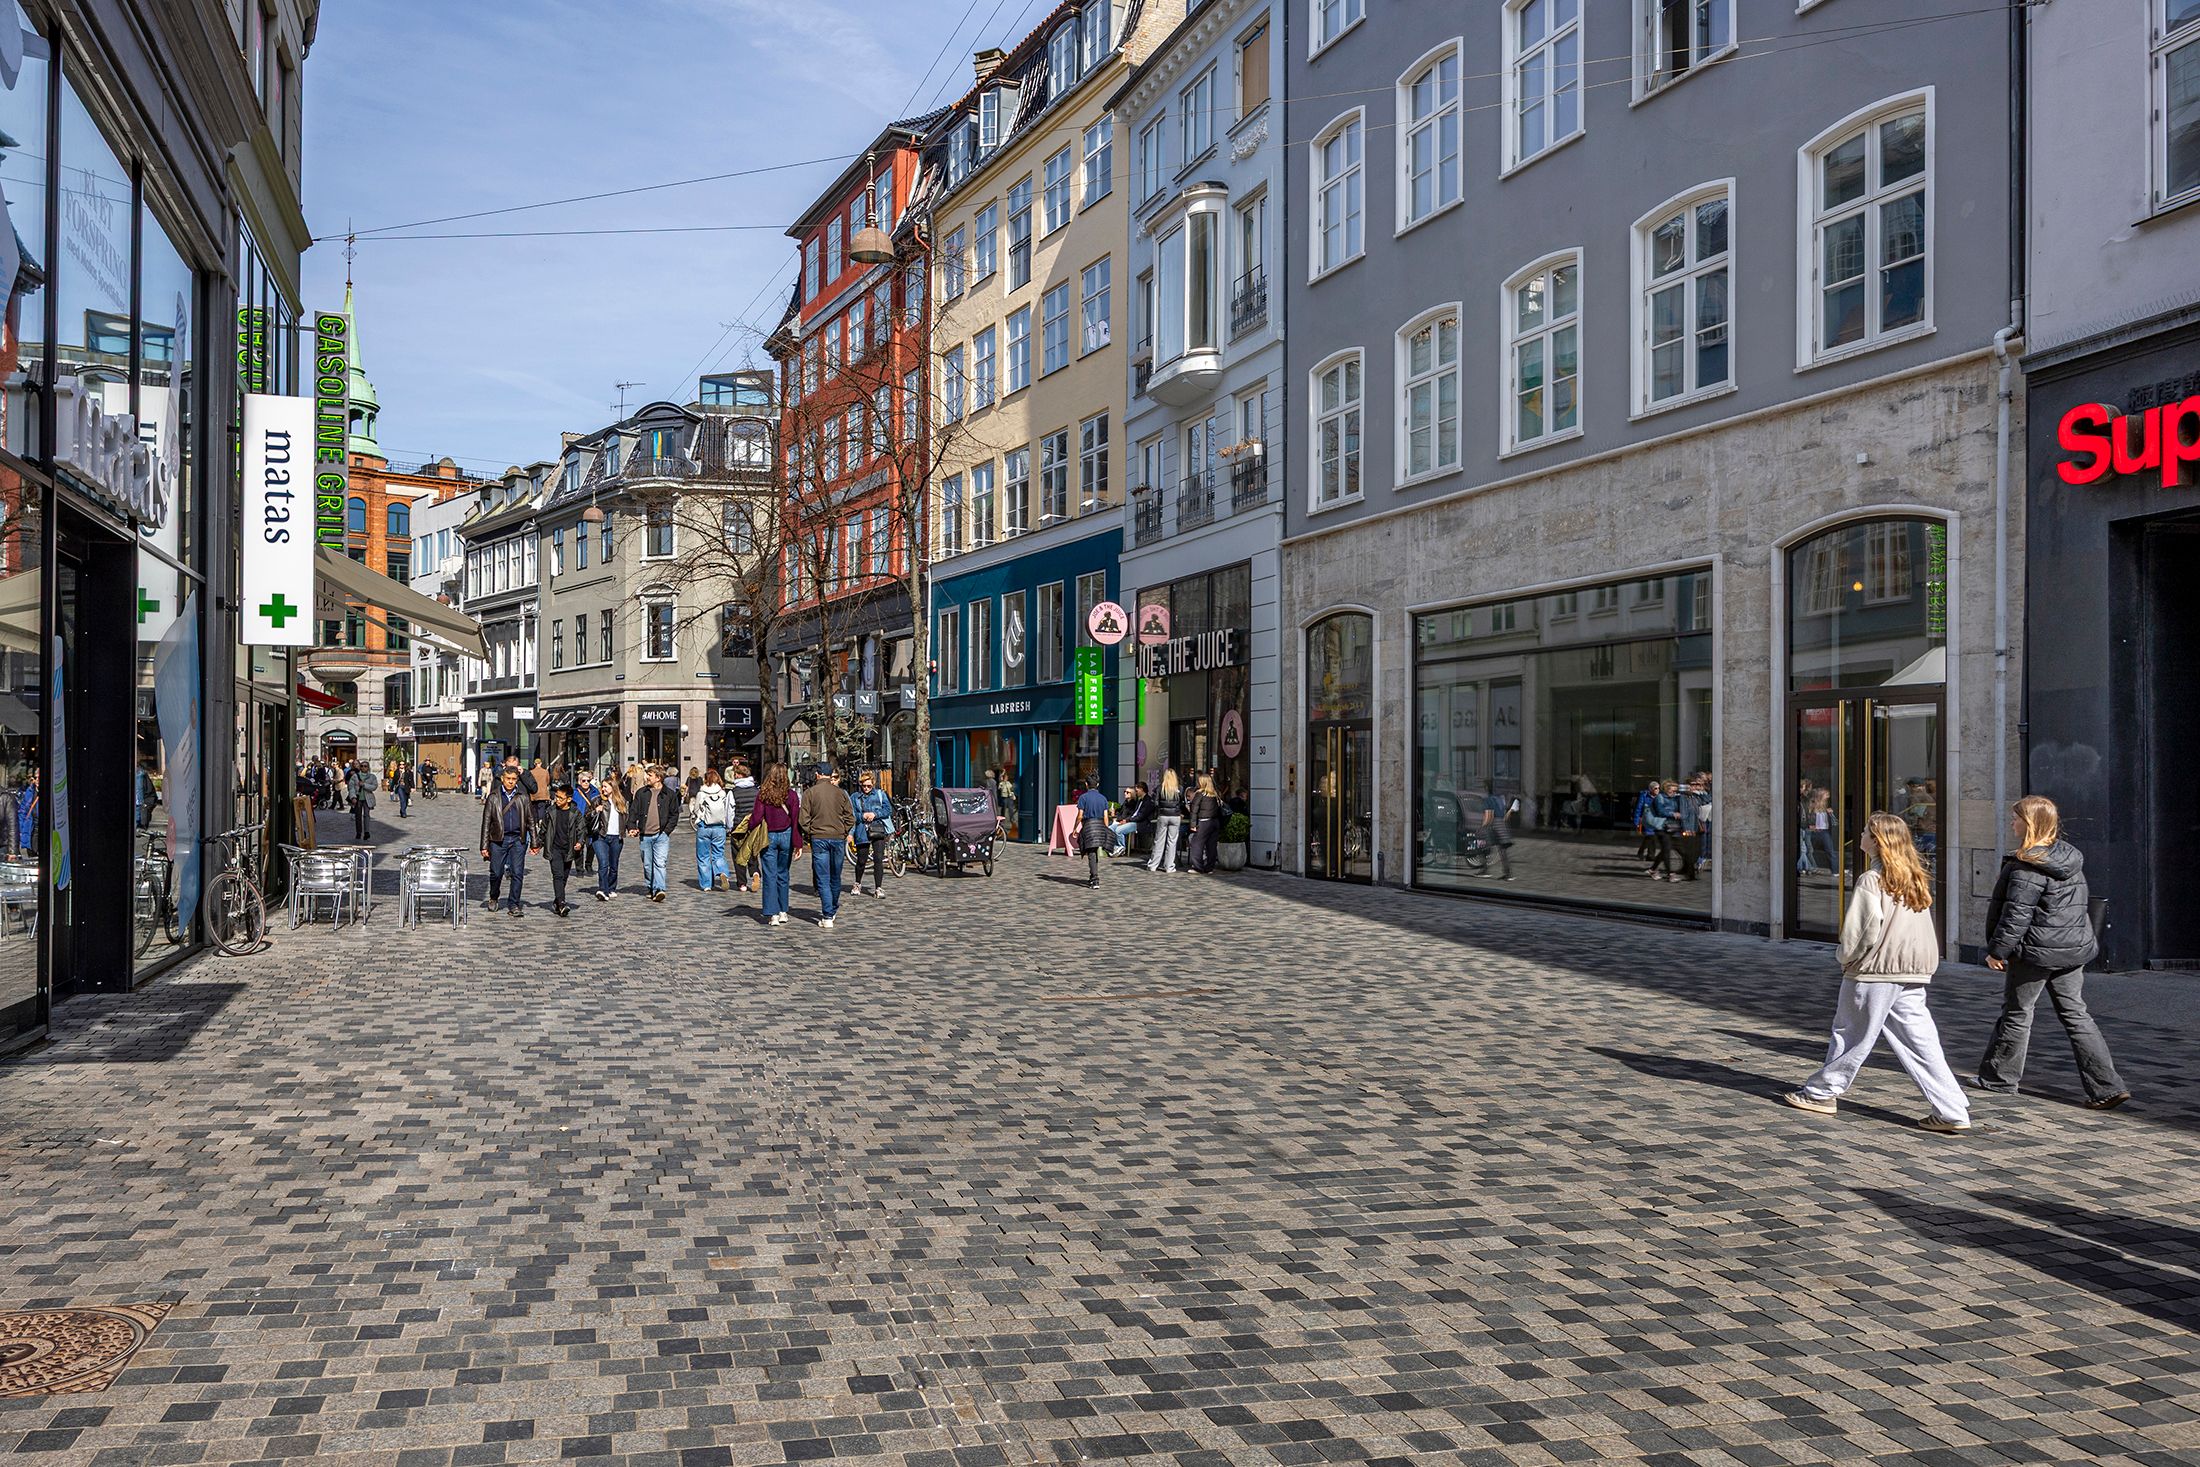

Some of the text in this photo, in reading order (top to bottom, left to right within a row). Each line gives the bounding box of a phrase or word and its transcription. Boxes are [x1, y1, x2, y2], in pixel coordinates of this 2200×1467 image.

[65, 186, 127, 289] FORSPRING
[317, 315, 346, 464] GASOLINE
[2056, 394, 2200, 488] Sup
[264, 429, 295, 543] matas
[1092, 609, 1100, 618] JOE
[1113, 608, 1125, 619] JUICE
[1136, 628, 1233, 679] JOE & THE JUICE
[859, 693, 873, 704] NÜ
[990, 701, 1031, 714] LABFRESH
[653, 711, 677, 720] HOME
[1259, 746, 1267, 755] 30
